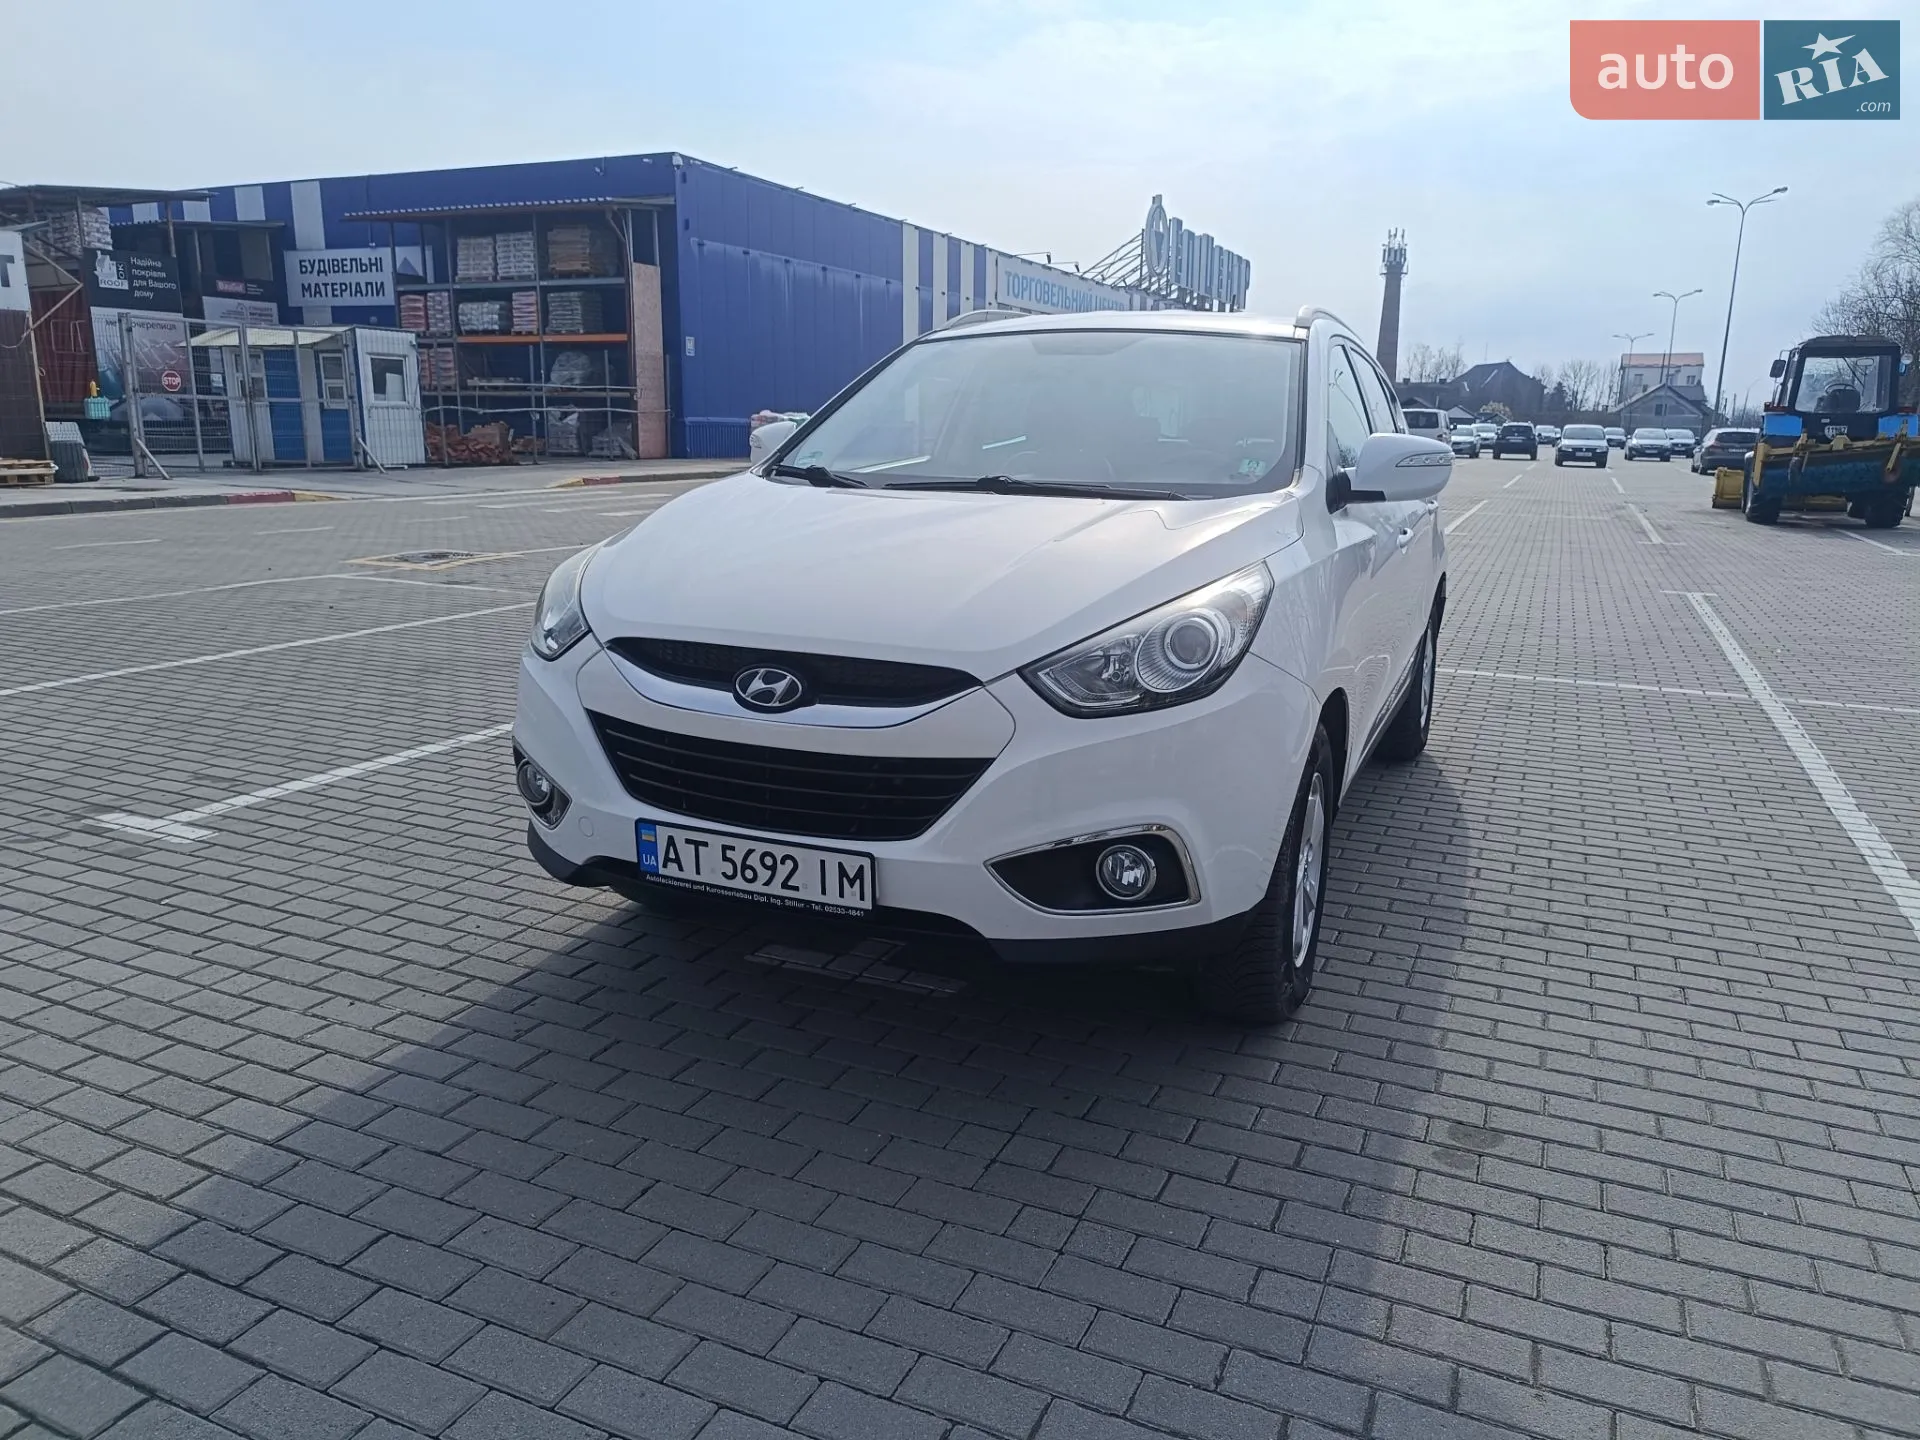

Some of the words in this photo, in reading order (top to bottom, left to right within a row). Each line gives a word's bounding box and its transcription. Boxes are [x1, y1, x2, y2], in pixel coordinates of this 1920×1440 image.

[130, 256, 163, 268] Надійна
[299, 257, 383, 276] БУДІВЕЛЬНІ
[131, 268, 167, 279] покрівля
[133, 279, 147, 287] для
[148, 279, 177, 290] Вашого
[301, 281, 385, 298] МАТЕРІАЛИ
[134, 290, 154, 300] дому
[1004, 270, 1093, 313] ТОРГОВЕЛЬНИЙ
[163, 377, 181, 386] STOP
[642, 853, 657, 866] UA
[662, 835, 709, 876] AT
[721, 844, 800, 892] 5692
[820, 859, 865, 902] IM
[770, 896, 783, 906] Ing.
[812, 903, 823, 911] Tel.
